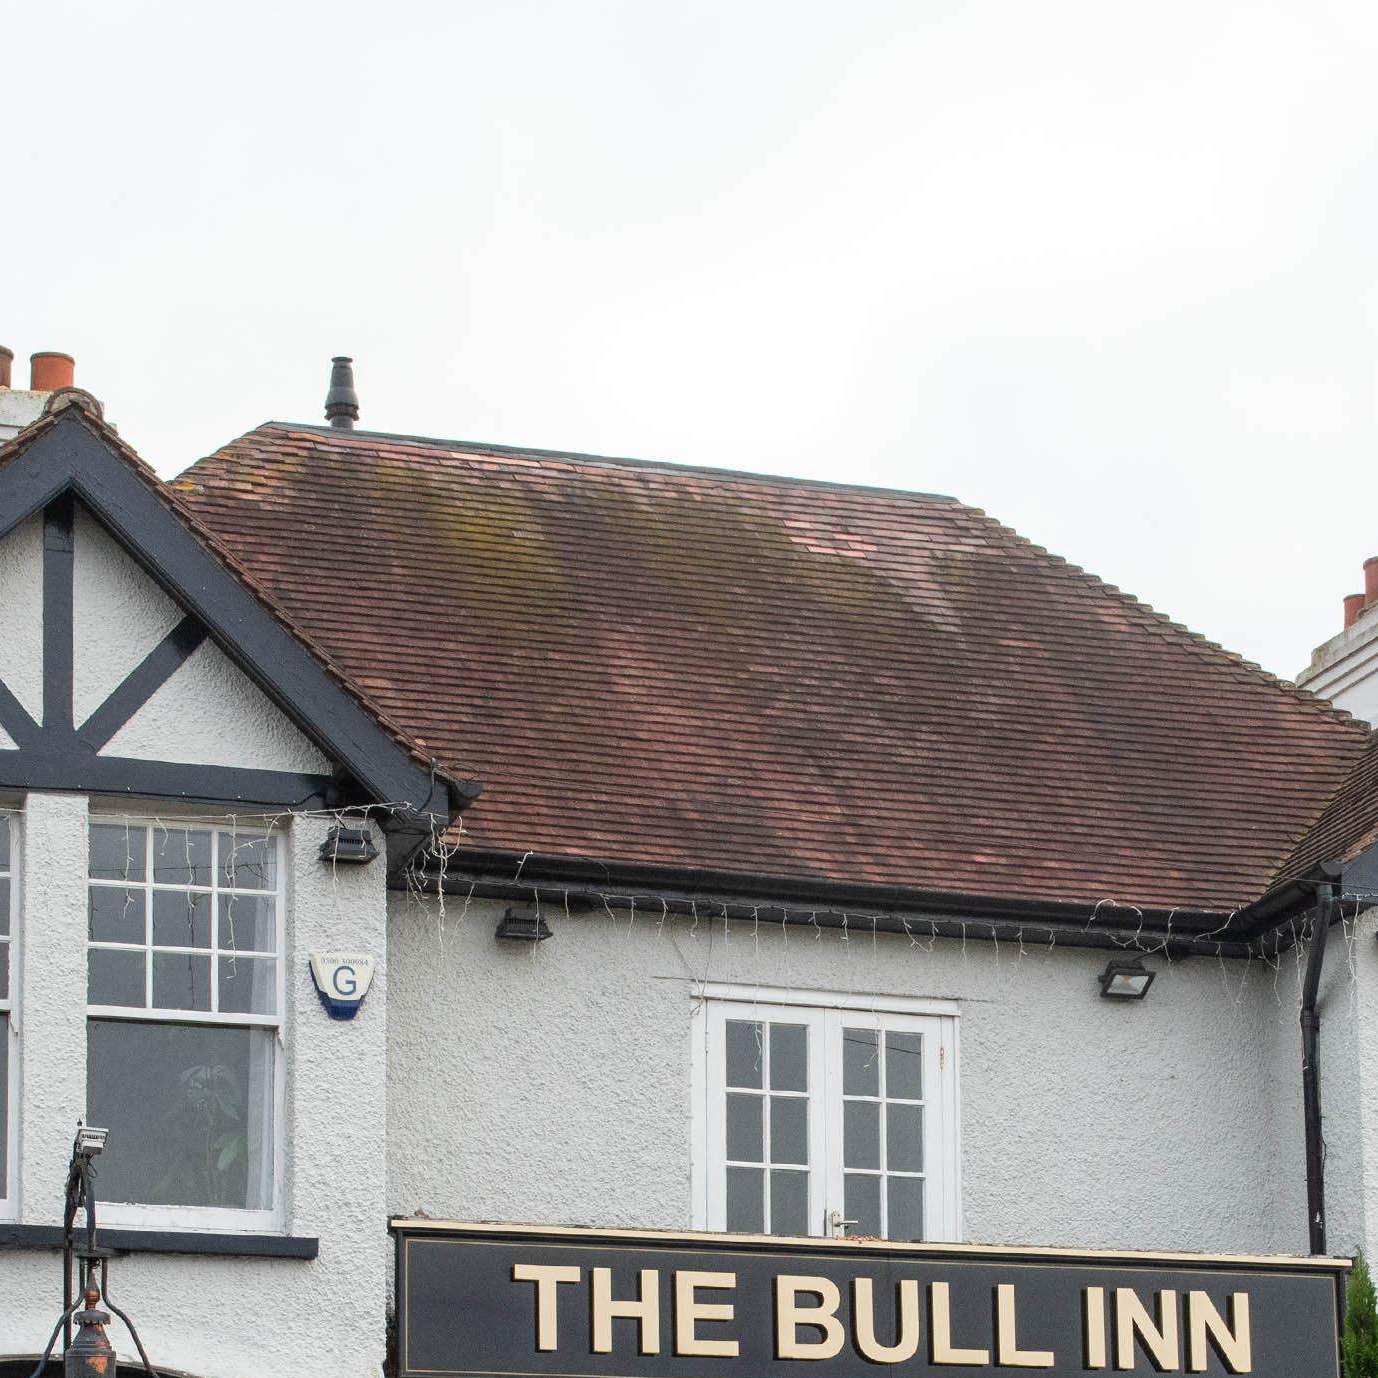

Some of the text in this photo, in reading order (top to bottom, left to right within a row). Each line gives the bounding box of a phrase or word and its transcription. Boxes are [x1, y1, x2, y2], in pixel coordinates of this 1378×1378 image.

[333, 965, 356, 995] G
[513, 1263, 1252, 1374] THE BULL INN
